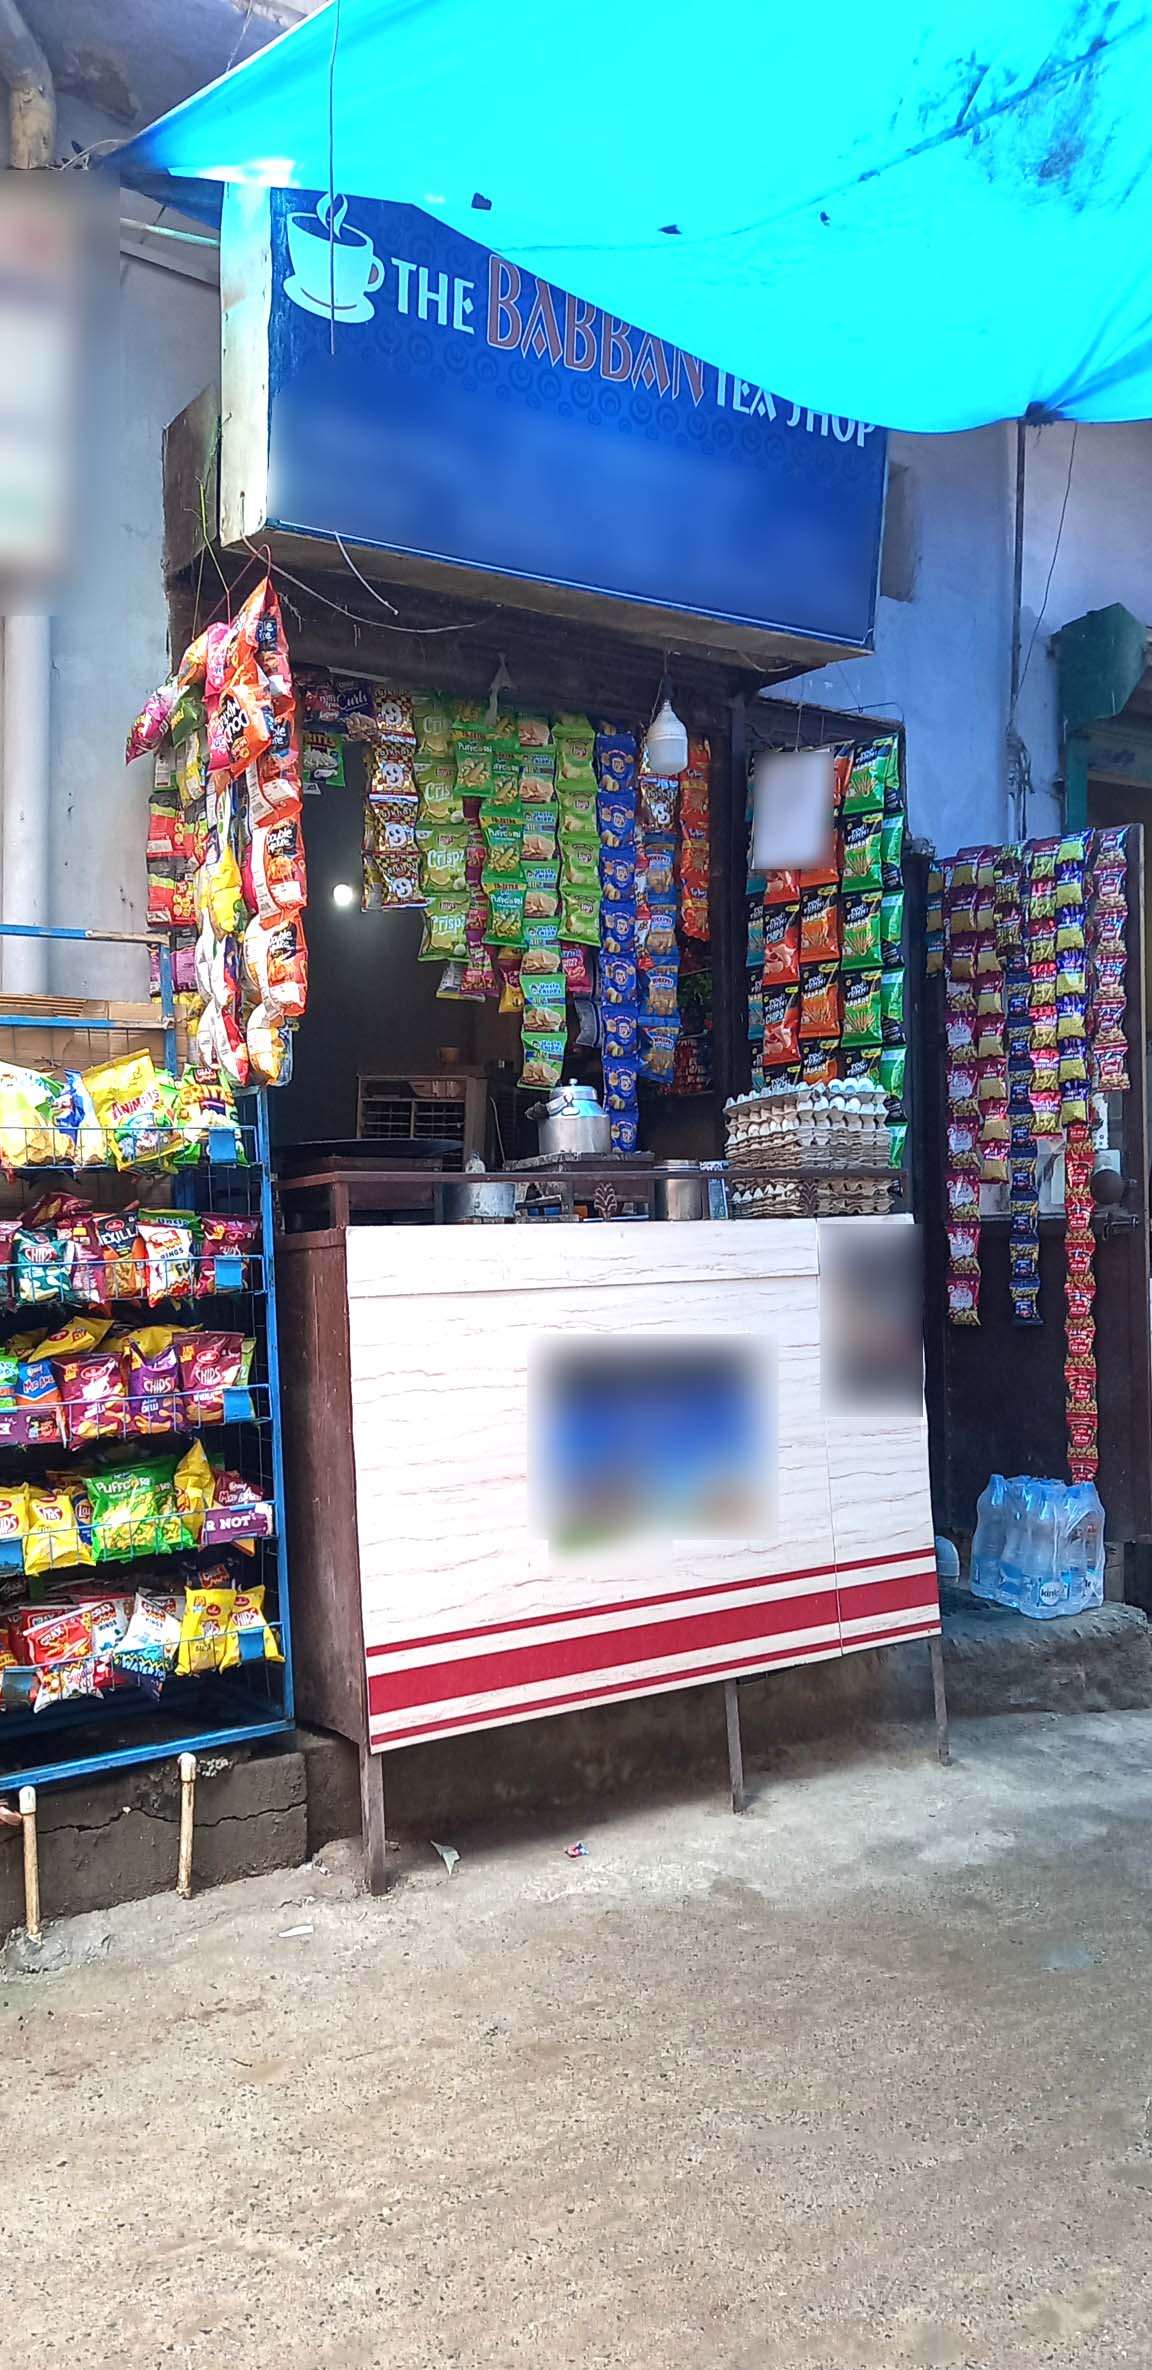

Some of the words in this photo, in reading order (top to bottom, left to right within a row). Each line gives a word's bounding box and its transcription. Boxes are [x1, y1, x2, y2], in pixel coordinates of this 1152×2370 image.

[391, 257, 475, 335] THE
[487, 254, 704, 407] BABBAN
[195, 1366, 221, 1382] CHIPS
[143, 1377, 172, 1393] CHIPS
[220, 1516, 250, 1530] NOT
[91, 1602, 113, 1617] CRAX
[231, 1610, 259, 1627] CHIPS
[40, 1626, 65, 1647] CRAX
